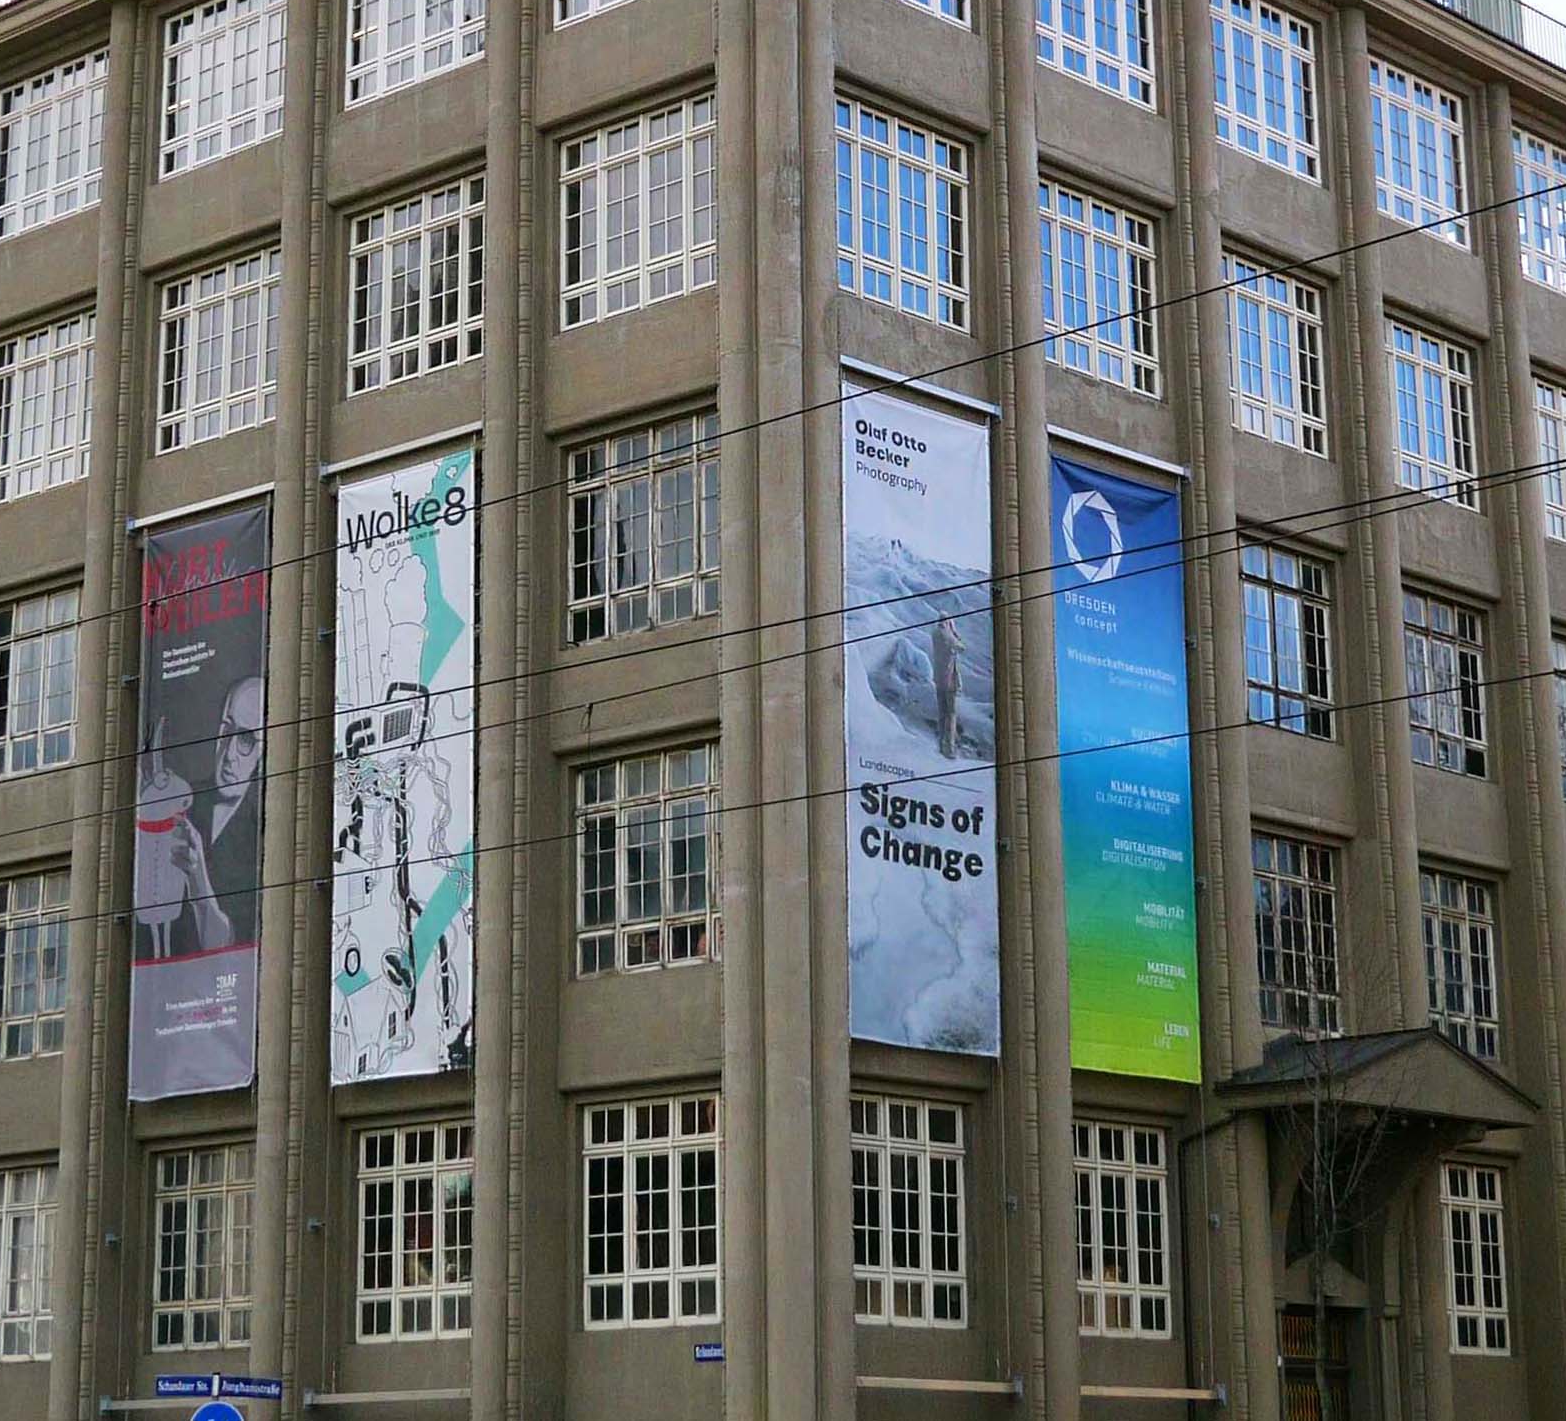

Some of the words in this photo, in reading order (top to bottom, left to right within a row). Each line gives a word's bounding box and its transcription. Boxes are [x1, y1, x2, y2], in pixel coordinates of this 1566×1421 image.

[855, 419, 887, 442] Olaf
[892, 431, 927, 454] Otto
[855, 439, 910, 468] Becker
[856, 460, 927, 496] Photography
[1064, 590, 1117, 616] DRESDEN
[1074, 613, 1118, 634] concept
[859, 756, 915, 778] Landscapes
[1110, 779, 1139, 796] KLIMA
[860, 782, 945, 829] Signs
[951, 806, 984, 836] of
[1095, 790, 1134, 809] CLIMATE
[1143, 799, 1171, 815] WATER
[860, 825, 984, 882] Change
[1147, 960, 1187, 980] MATERIAL
